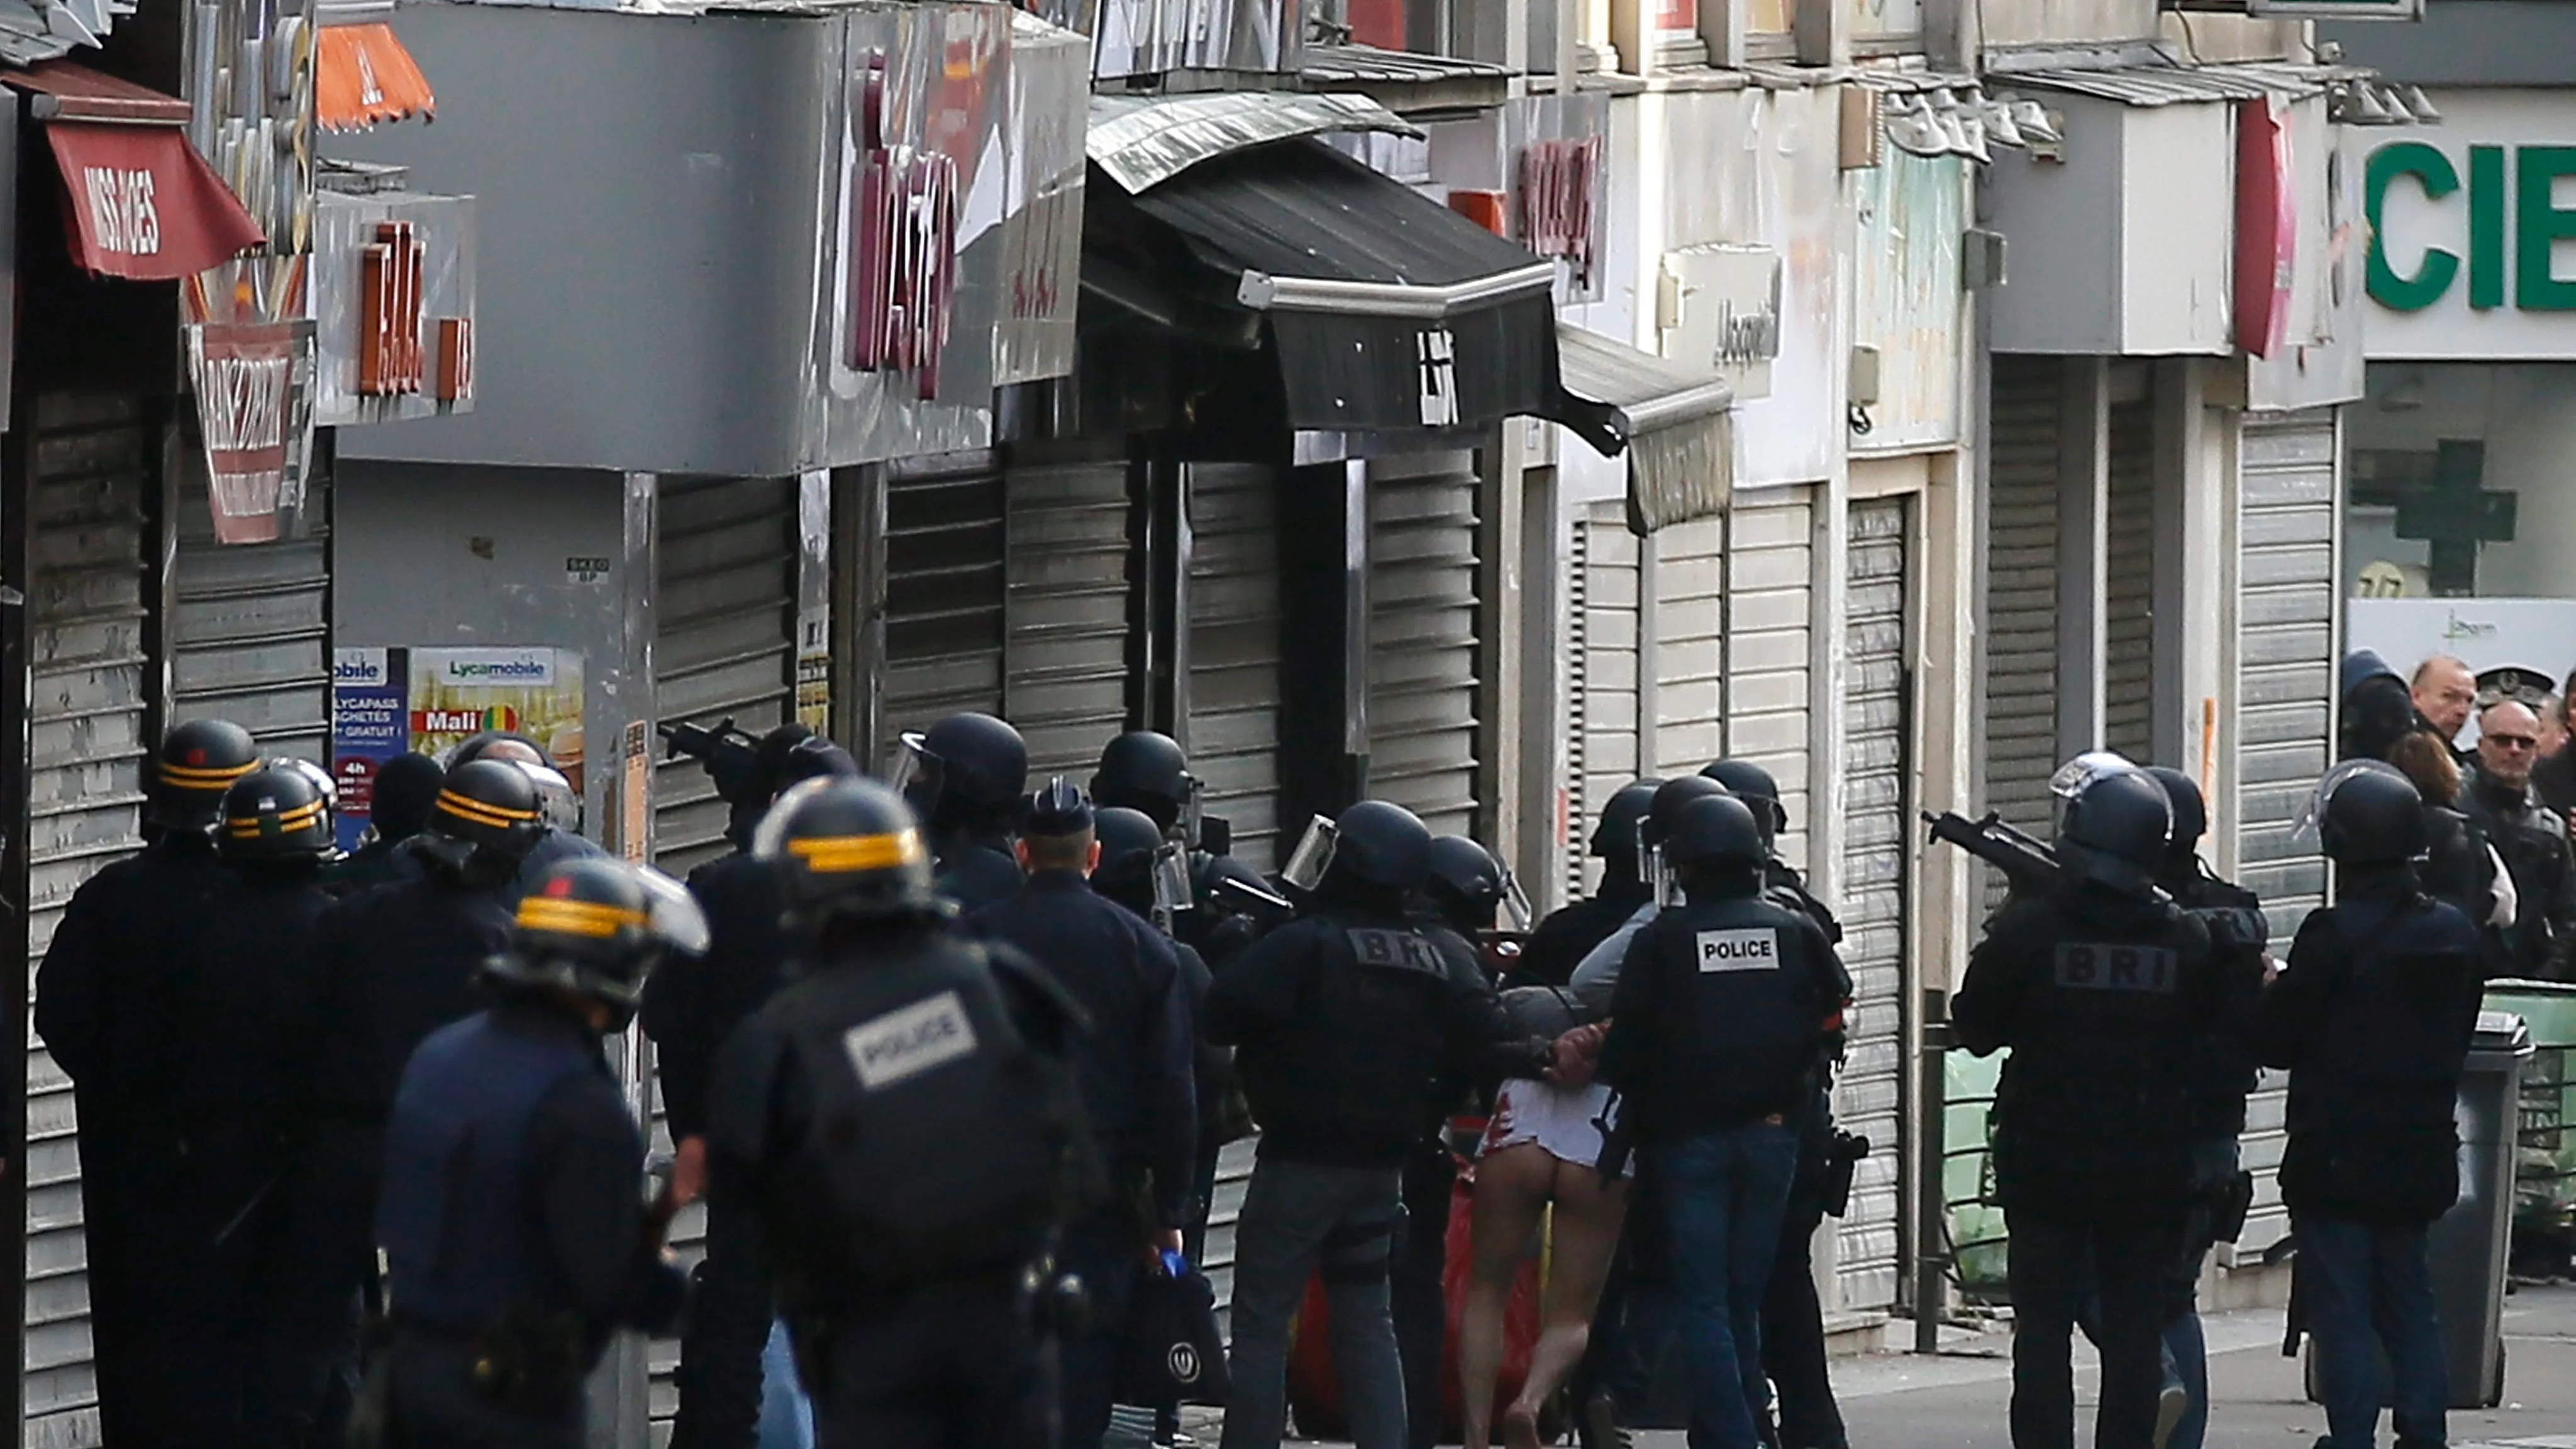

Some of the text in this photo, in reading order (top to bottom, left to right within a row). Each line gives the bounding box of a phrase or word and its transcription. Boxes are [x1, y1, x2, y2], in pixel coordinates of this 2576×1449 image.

[450, 660, 544, 678] Lycamobile
[426, 712, 476, 730] Mali
[345, 726, 394, 737] GRATUIT
[345, 762, 365, 774] 4h
[1705, 941, 1772, 959] POLICE
[2066, 945, 2166, 987] BRI
[862, 1013, 961, 1068] POLICE
